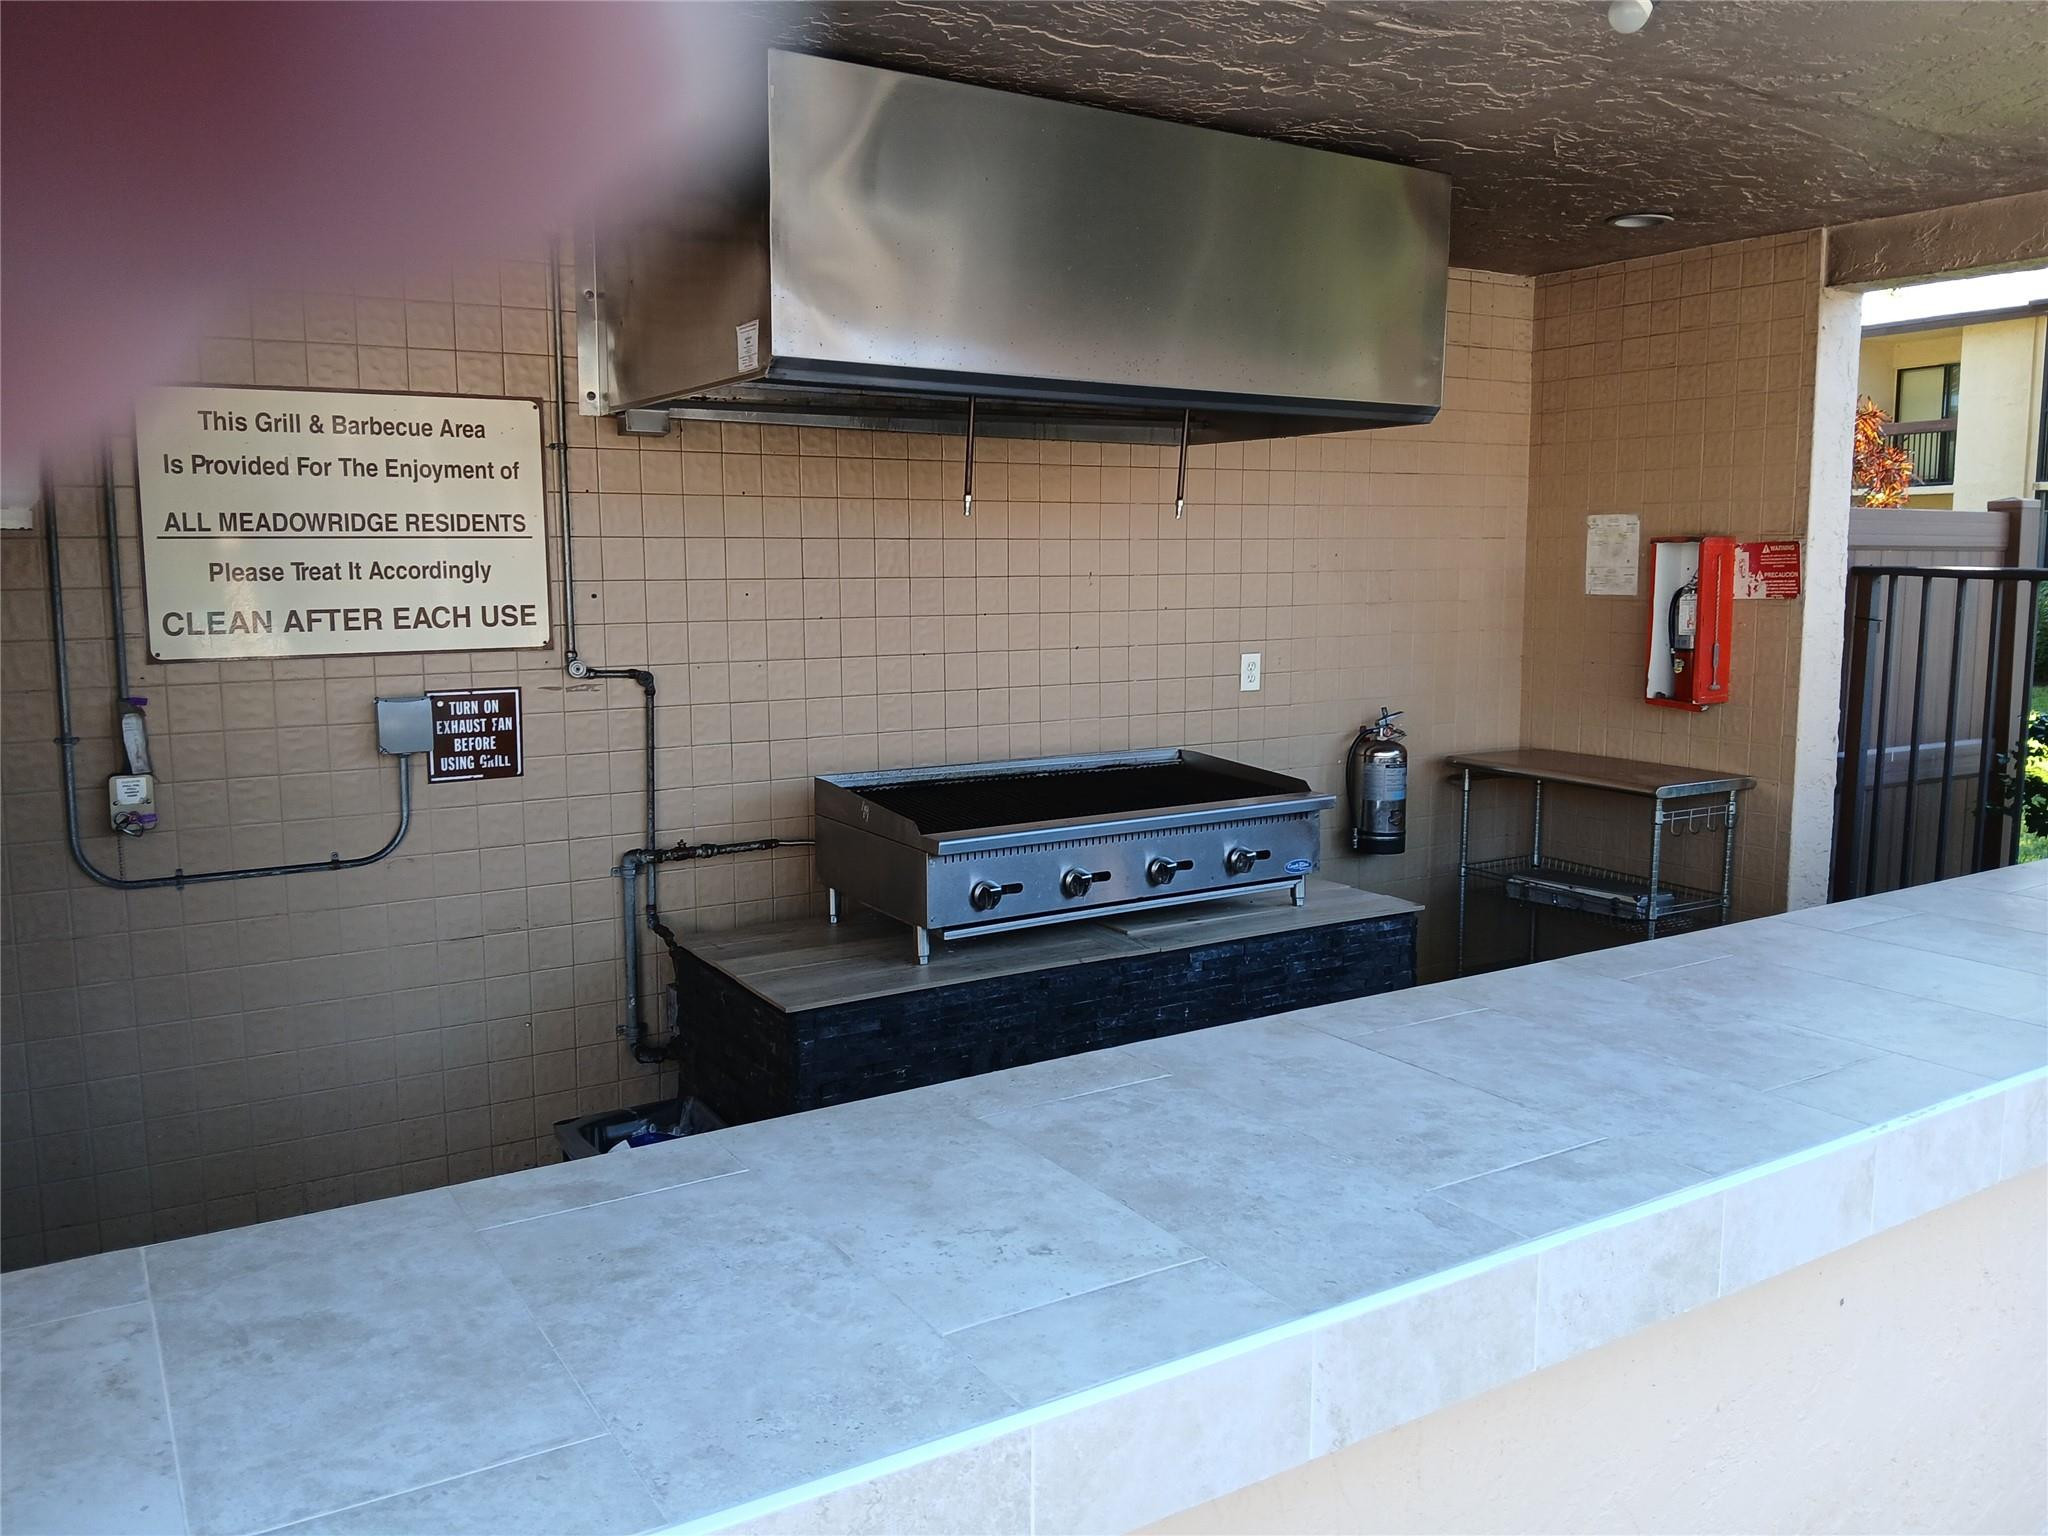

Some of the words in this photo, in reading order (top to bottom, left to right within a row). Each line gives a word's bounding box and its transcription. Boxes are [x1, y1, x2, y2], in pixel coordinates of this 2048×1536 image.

[197, 410, 248, 432] This
[254, 412, 301, 433] Grill
[308, 414, 325, 434] &
[331, 415, 433, 437] Barbecue
[439, 418, 486, 439] Area
[163, 453, 184, 475] Is
[191, 454, 289, 476] Provided
[296, 456, 332, 477] For
[338, 457, 378, 478] The
[385, 458, 495, 484] Enjoyment
[499, 461, 520, 480] of
[164, 511, 212, 533] ALL
[218, 512, 399, 533] MEADOWRIDGE
[405, 513, 527, 533] RESIDENTS
[208, 562, 285, 583] Please
[290, 561, 342, 582] Treat
[348, 561, 362, 581] It
[369, 560, 492, 584] Accordingly
[162, 609, 273, 637] CLEAN
[283, 608, 383, 633] AFTER
[393, 605, 472, 630] EACH
[481, 604, 537, 628] USE
[449, 701, 479, 716] TURN
[484, 699, 499, 714] ON
[436, 718, 486, 734] EXHAUST
[491, 716, 513, 731] FAN
[454, 736, 497, 752] BEFORE
[440, 755, 474, 771] USING
